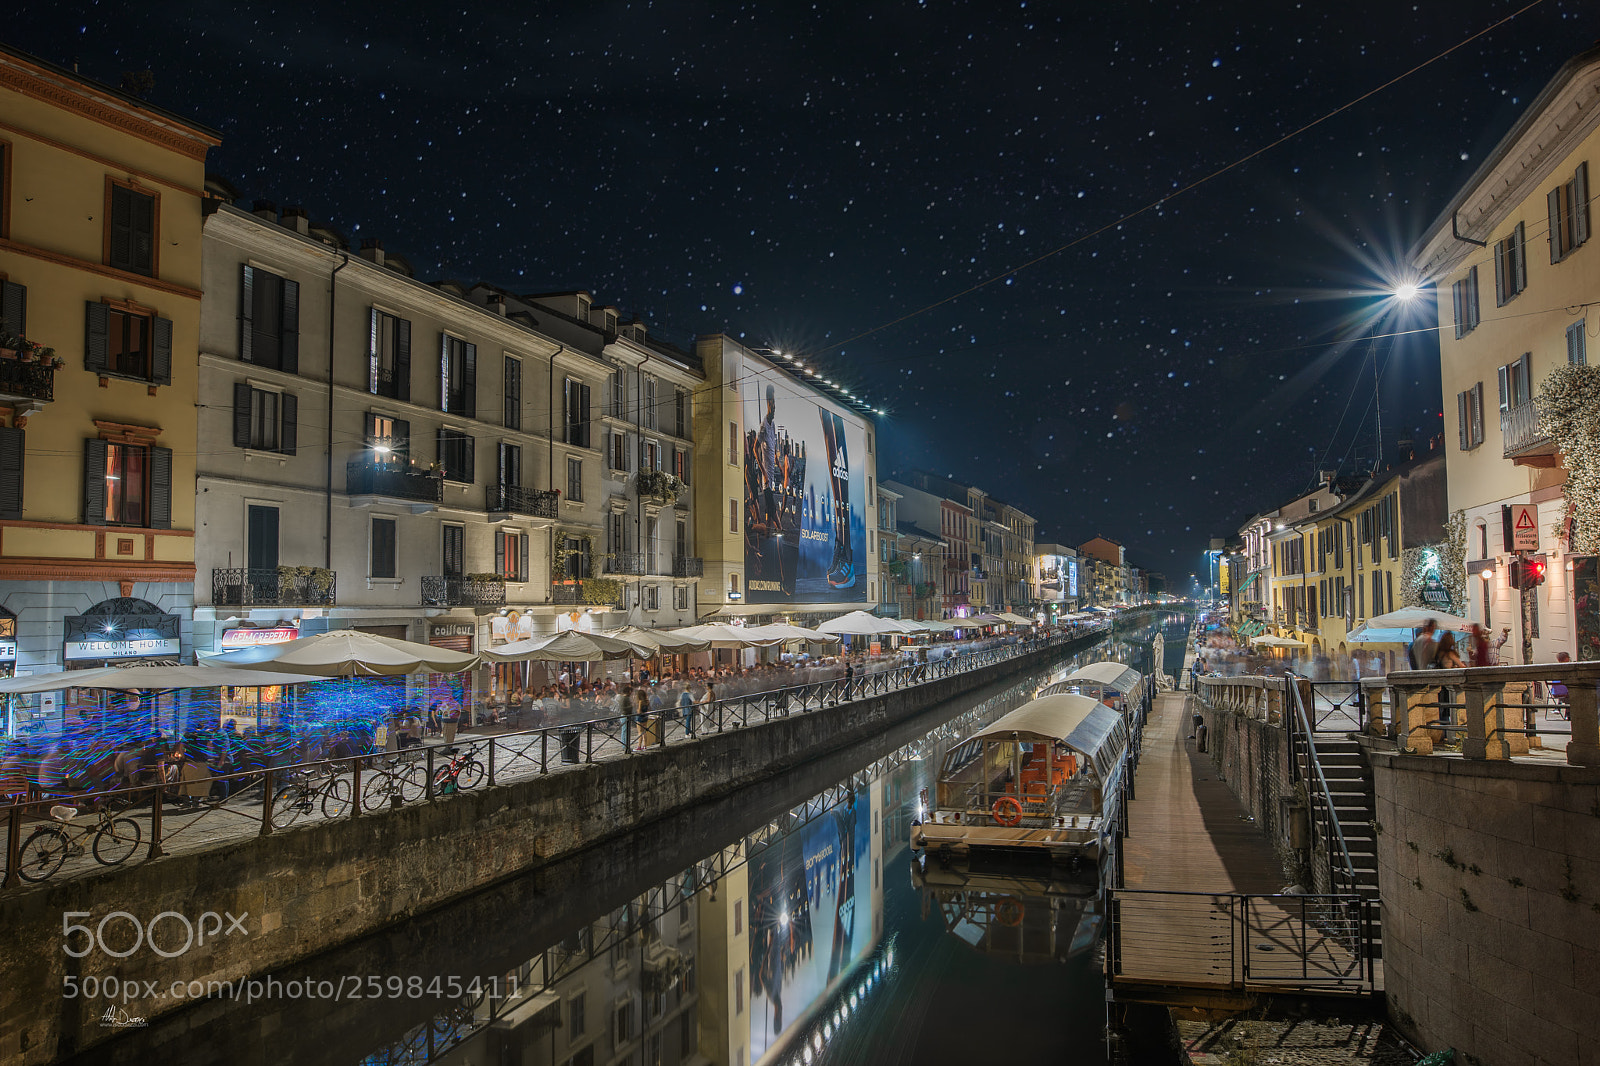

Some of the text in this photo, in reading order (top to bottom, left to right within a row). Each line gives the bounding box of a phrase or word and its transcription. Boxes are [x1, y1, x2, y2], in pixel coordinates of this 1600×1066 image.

[832, 466, 849, 481] adidas
[802, 528, 828, 541] SOLARBOOST
[435, 624, 471, 636] coiffeur
[79, 639, 169, 650] WELCOME HOME
